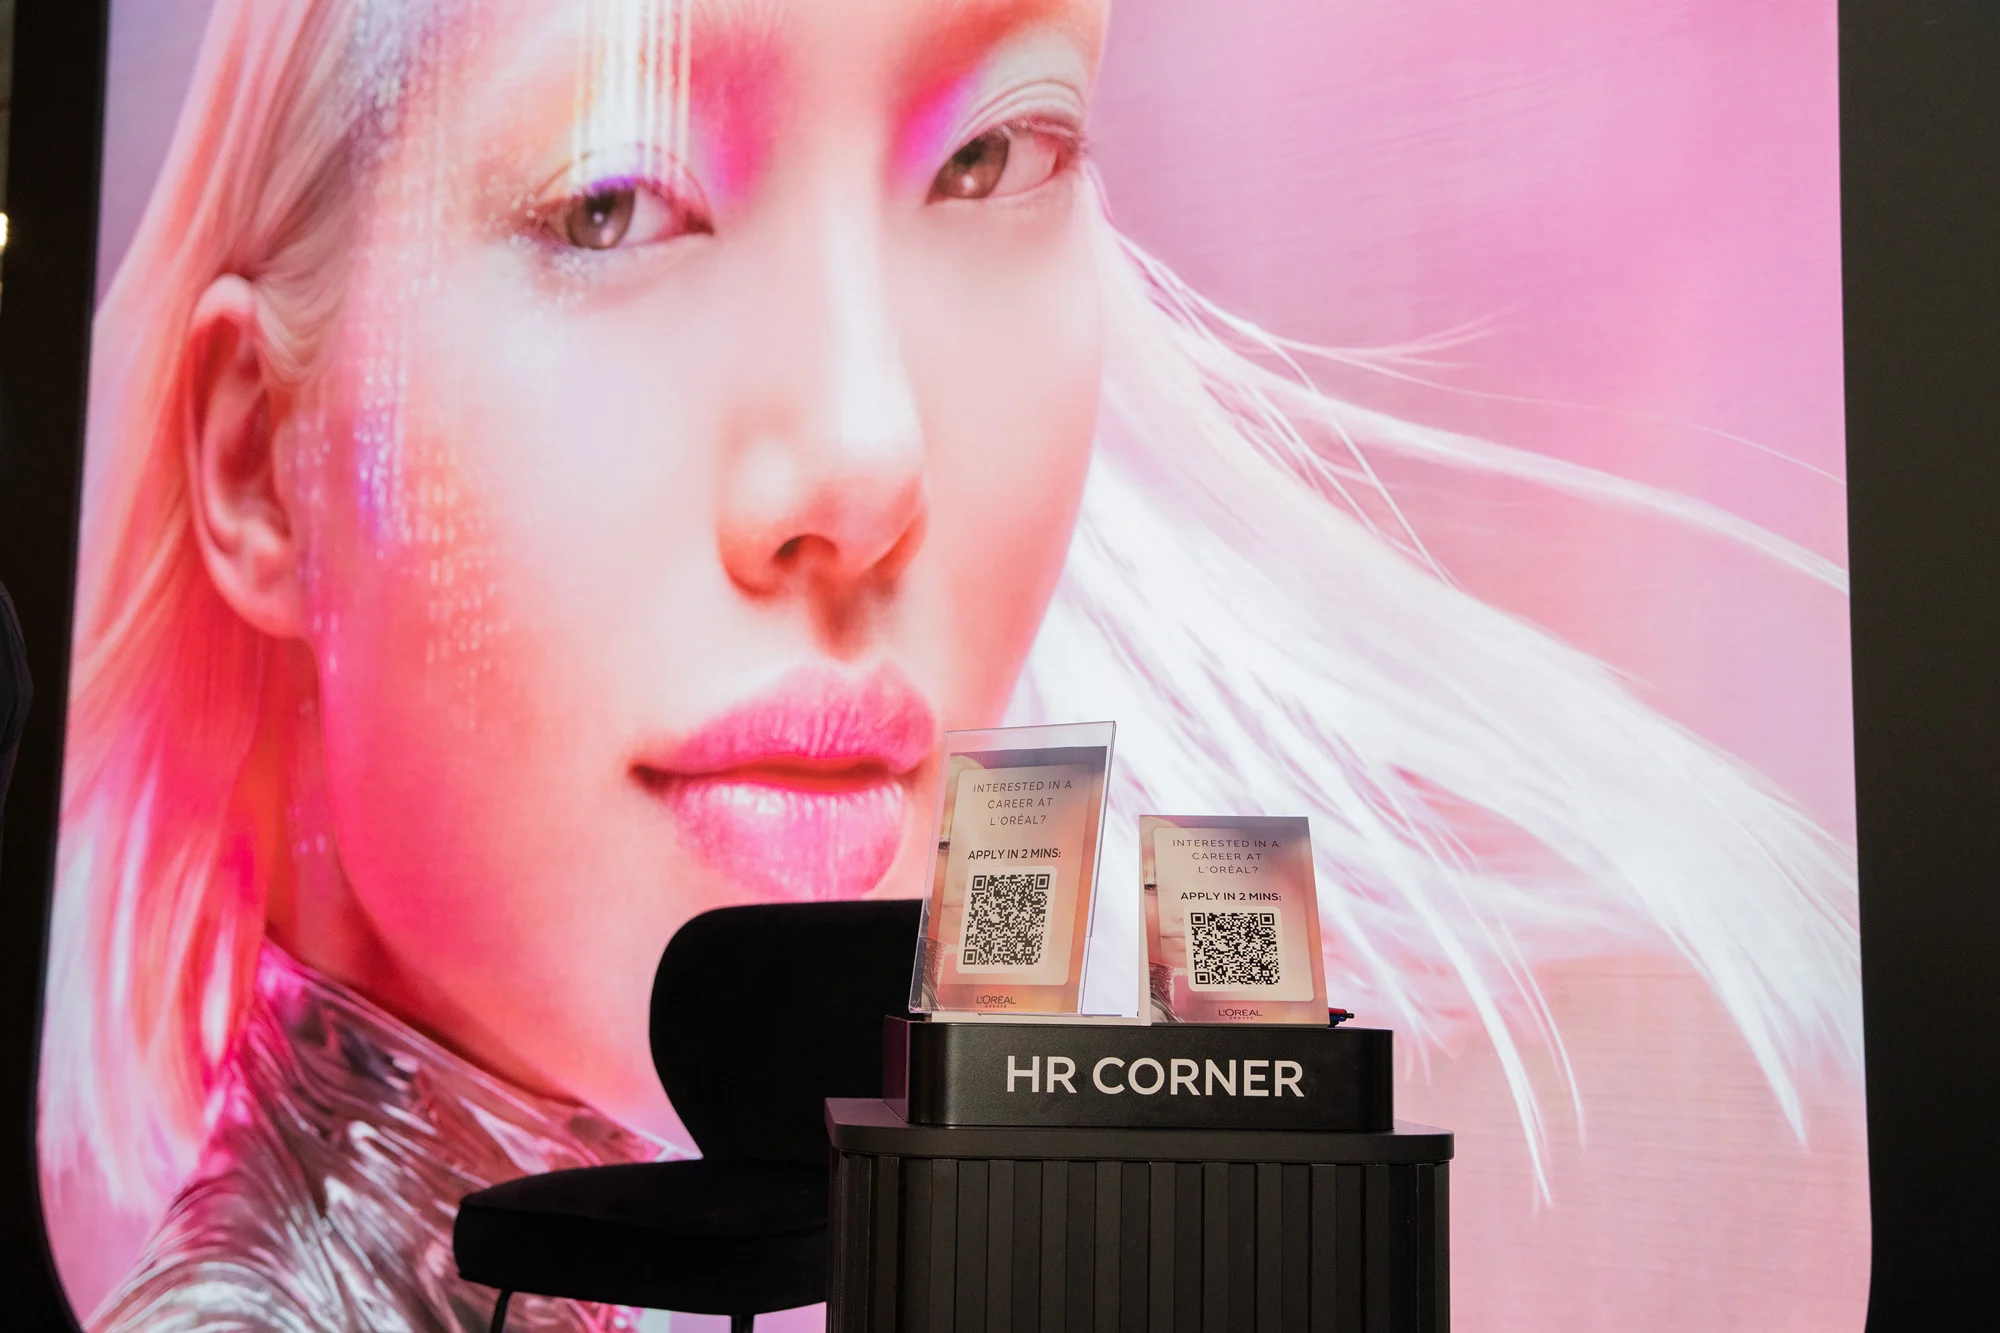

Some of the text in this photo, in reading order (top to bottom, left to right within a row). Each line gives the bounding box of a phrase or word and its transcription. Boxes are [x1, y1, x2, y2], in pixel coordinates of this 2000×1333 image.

[973, 780, 1072, 793] INTERESTED IN A
[987, 797, 1053, 809] CAREER AT
[990, 813, 1046, 826] L'ORÉAL?
[1172, 839, 1280, 848] INTERESTED IN A
[967, 847, 1061, 860] APPLY IN 2 MINS:
[1191, 852, 1262, 861] CAREER AT
[1198, 864, 1259, 874] L'ORÉAL?
[1180, 892, 1282, 901] APPLY IN 2 MINS:
[1006, 1055, 1305, 1098] HR CORNER
